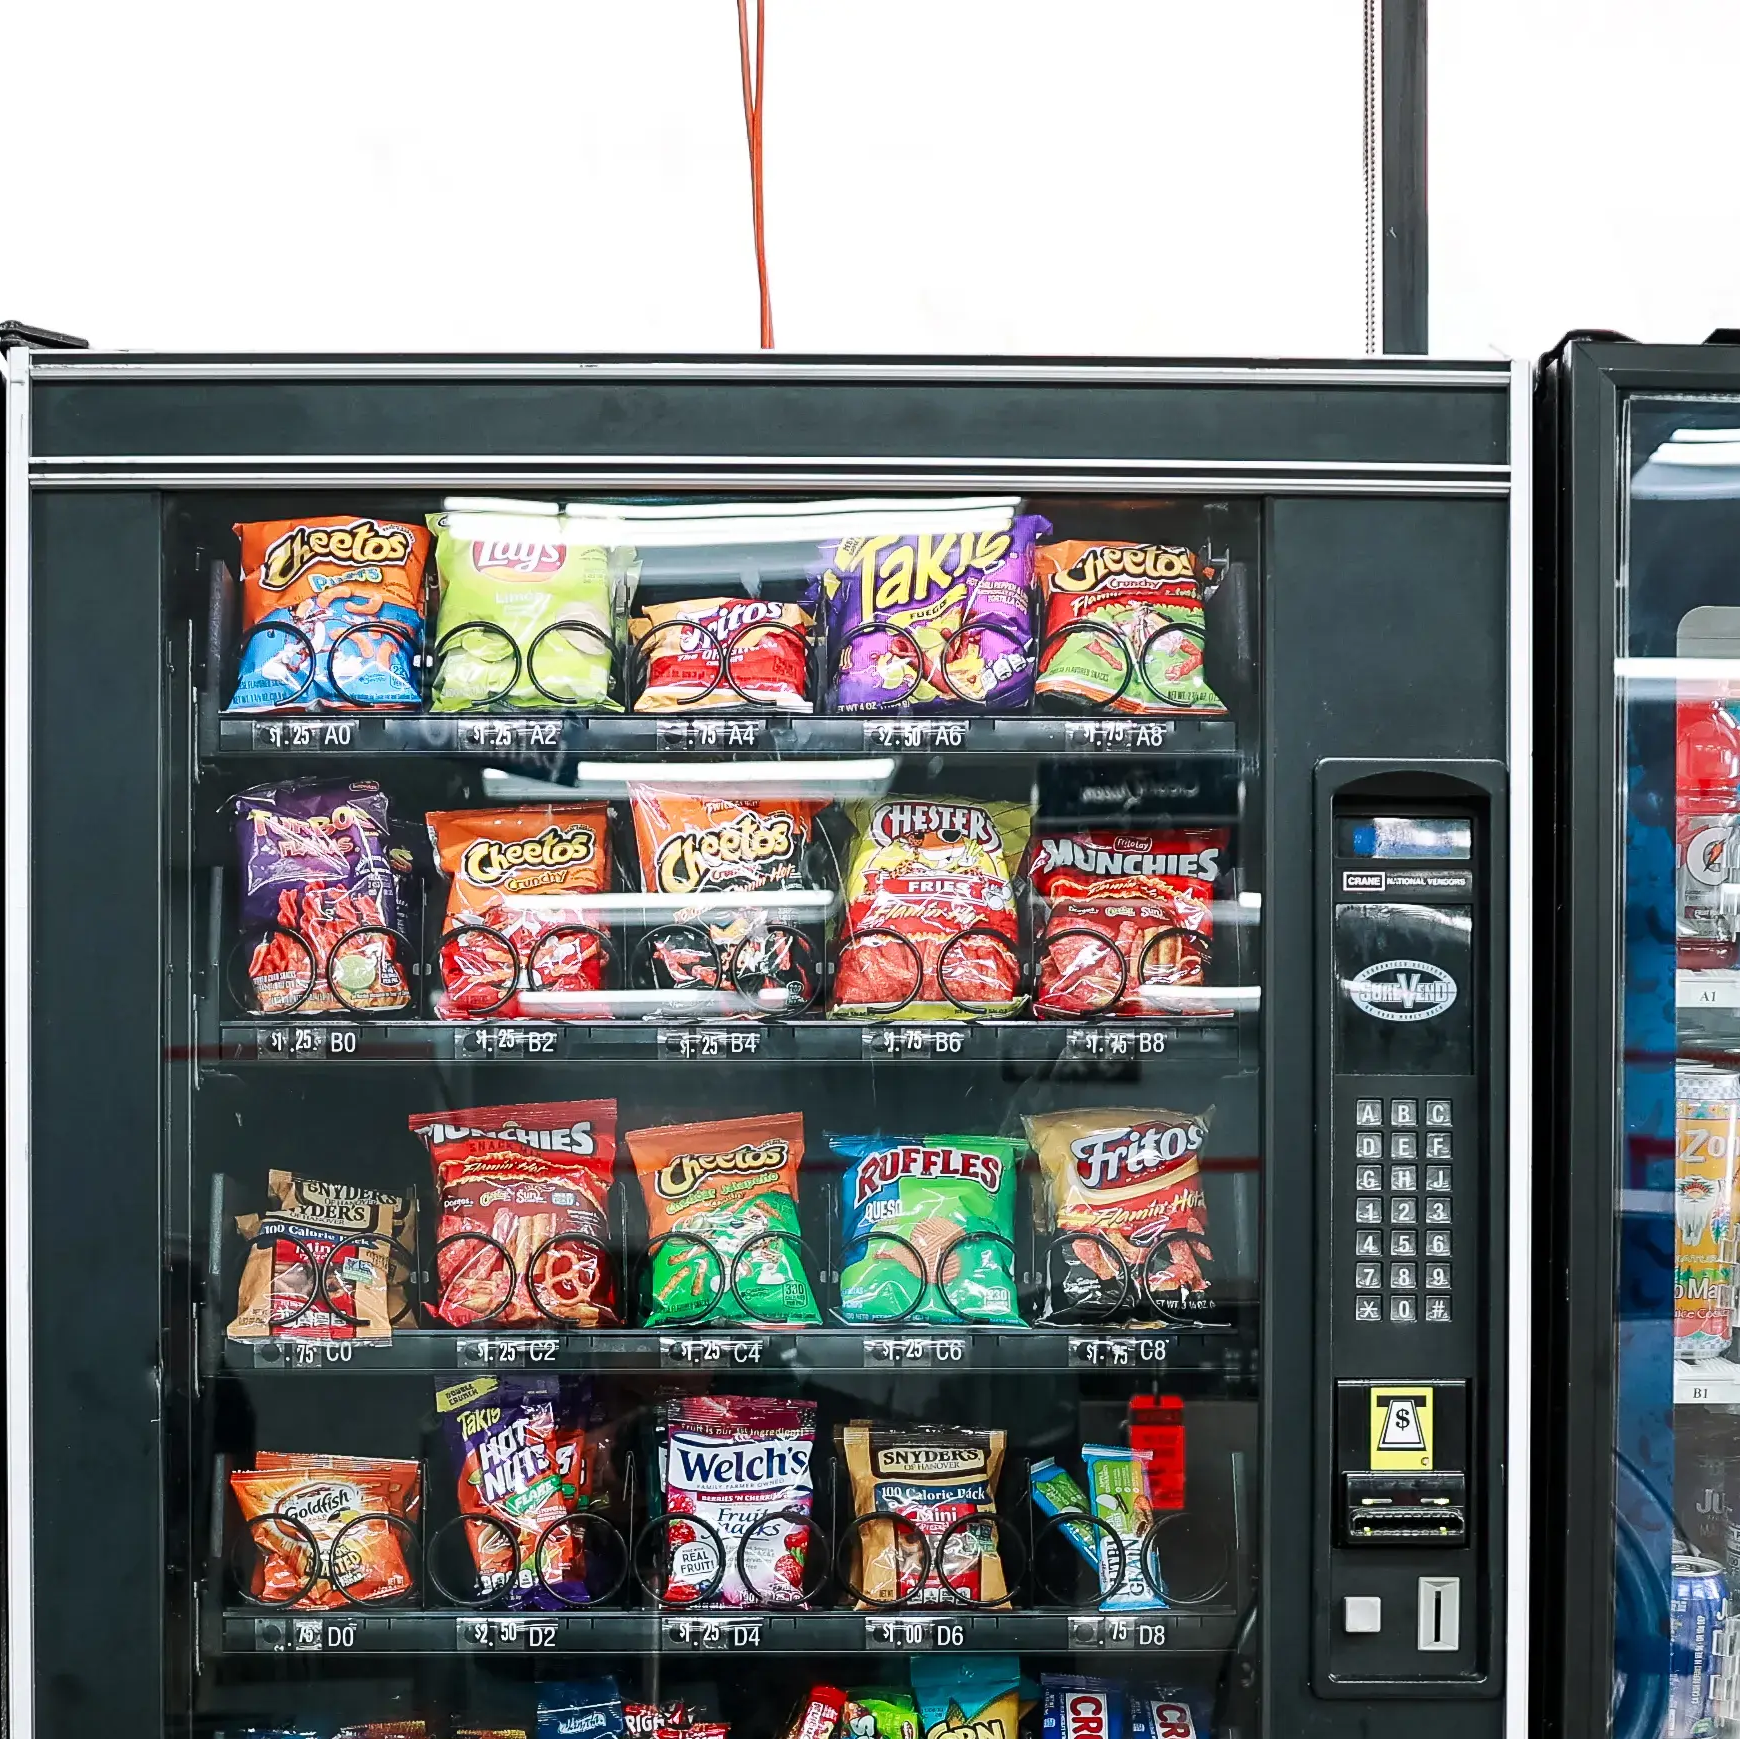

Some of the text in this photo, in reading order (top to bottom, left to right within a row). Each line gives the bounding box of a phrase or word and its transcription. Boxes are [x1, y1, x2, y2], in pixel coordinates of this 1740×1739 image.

[259, 519, 411, 589] Cheetos
[858, 521, 1012, 618] Takis
[909, 603, 948, 621] FUEGO
[679, 602, 783, 652] Fritos
[324, 726, 351, 746] A0
[872, 802, 1001, 850] CHESTER'S
[465, 830, 592, 879] Cheetos
[1042, 839, 1219, 882] MUNCHIES
[504, 869, 567, 892] Crunchy
[908, 880, 970, 895] FRIES
[1347, 876, 1381, 886] CRANE
[1427, 878, 1465, 886] VENDORS
[1071, 1125, 1203, 1185] Fritos
[857, 1147, 1001, 1205] RUFFLES
[865, 1200, 903, 1219] QUESO
[1172, 1193, 1204, 1214] Hot
[530, 1342, 556, 1361] C2
[457, 1407, 501, 1441] Takis
[479, 1418, 529, 1471] HOT
[882, 1449, 981, 1466] SNYDER'S
[484, 1444, 550, 1504] NUTS
[677, 1447, 809, 1484] Welch's
[903, 1460, 961, 1471] OF HANOVER
[284, 1488, 352, 1523] Goldfish
[881, 1485, 986, 1500] 100 Calorie Pack
[680, 1561, 715, 1573] FRUIT!
[682, 1552, 709, 1562] REAL
